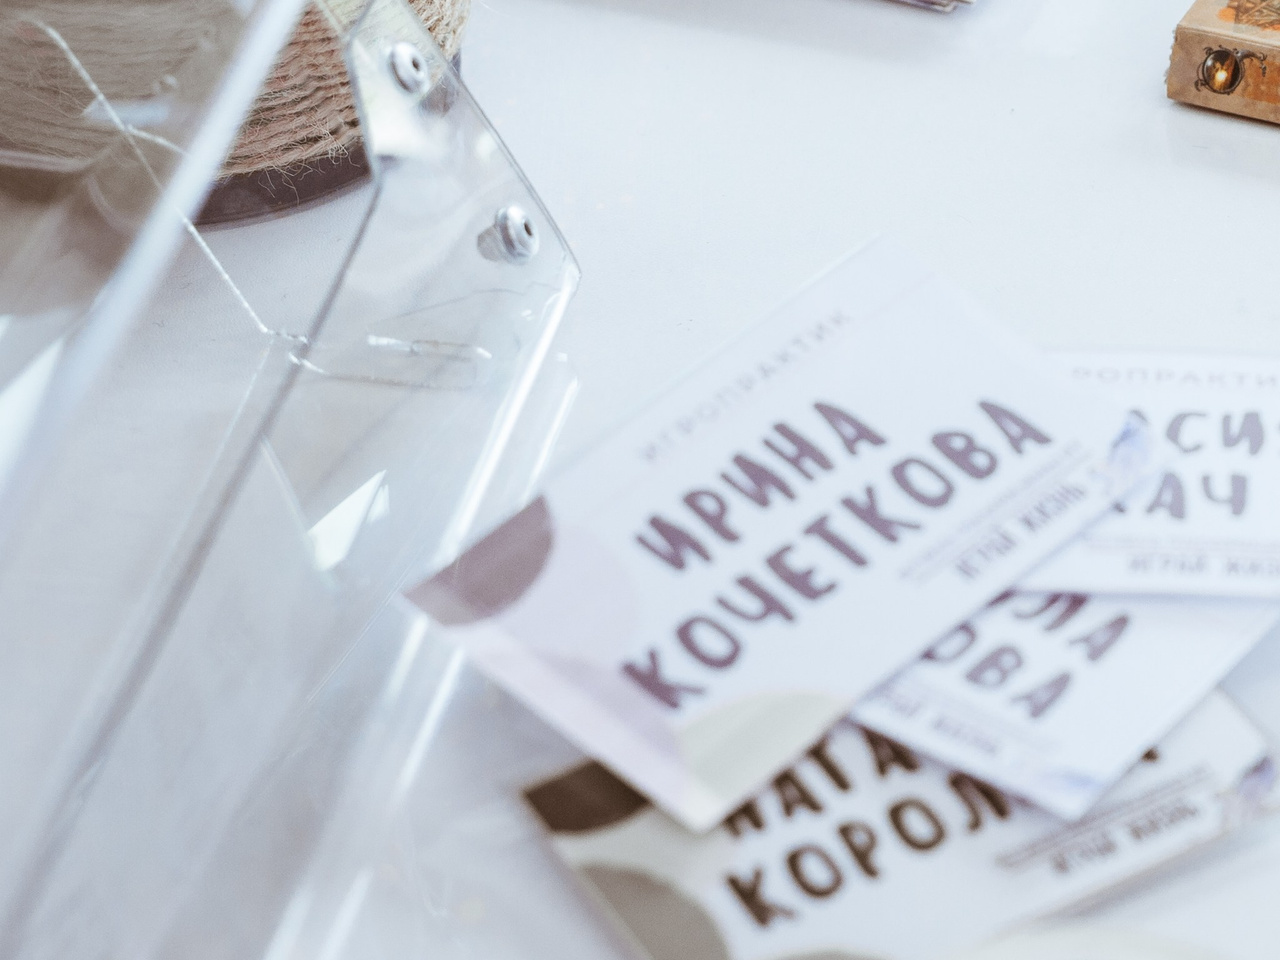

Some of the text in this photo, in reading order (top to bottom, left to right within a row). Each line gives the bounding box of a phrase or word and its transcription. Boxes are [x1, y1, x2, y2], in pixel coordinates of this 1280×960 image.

[622, 400, 1053, 710] КОЧЕТКОВА
[636, 401, 888, 572] ИРИНА
[1111, 471, 1248, 520] АЧ
